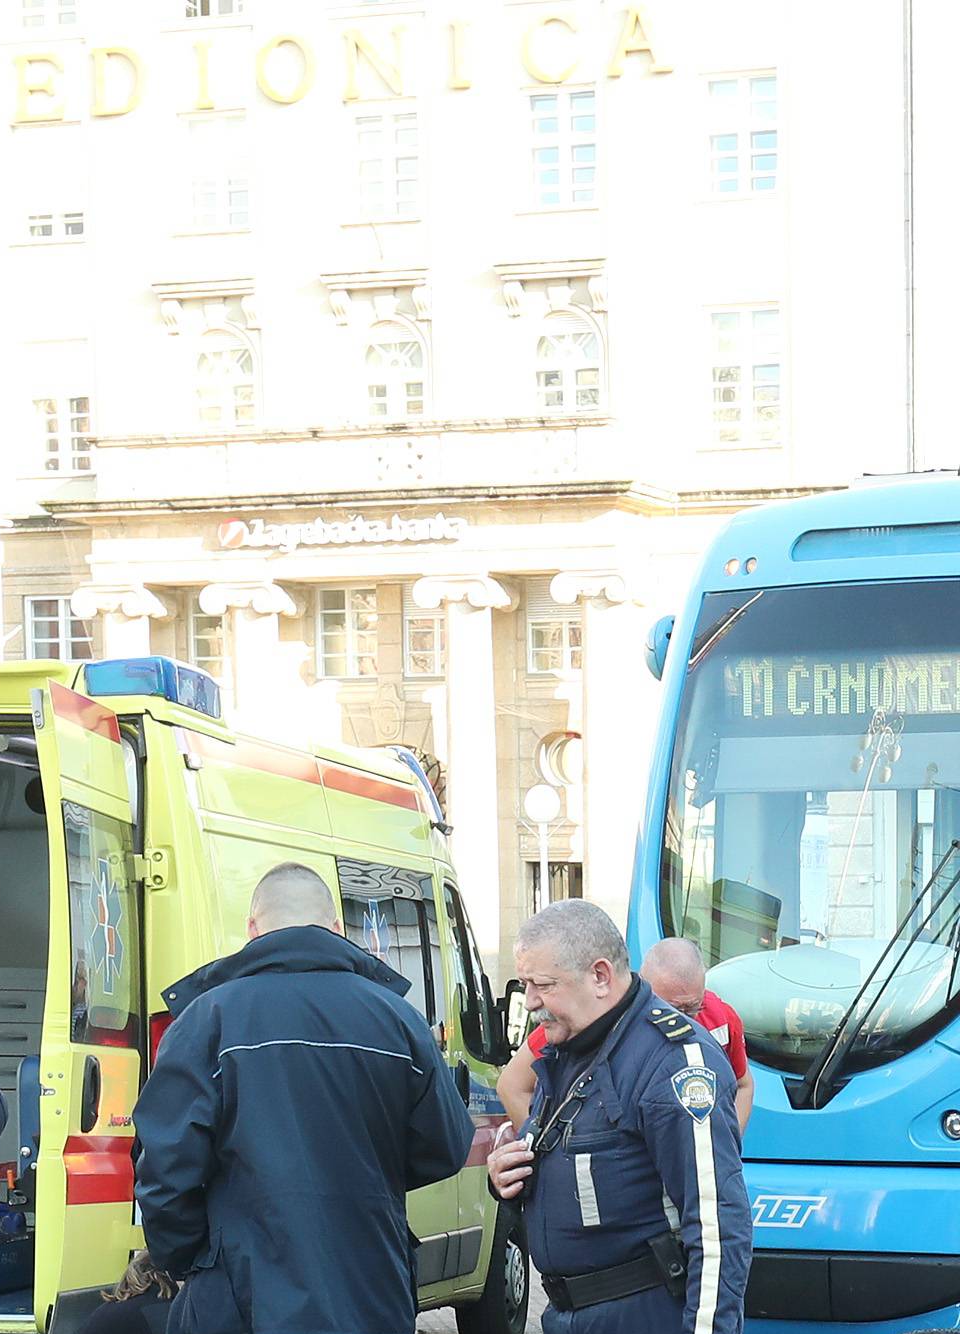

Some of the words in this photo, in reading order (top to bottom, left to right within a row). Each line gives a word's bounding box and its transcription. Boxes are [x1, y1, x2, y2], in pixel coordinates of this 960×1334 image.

[735, 657, 774, 717] 11
[787, 655, 960, 716] ČRNOME
[675, 1069, 714, 1084] POLICIJA
[751, 1194, 828, 1229] ZET
